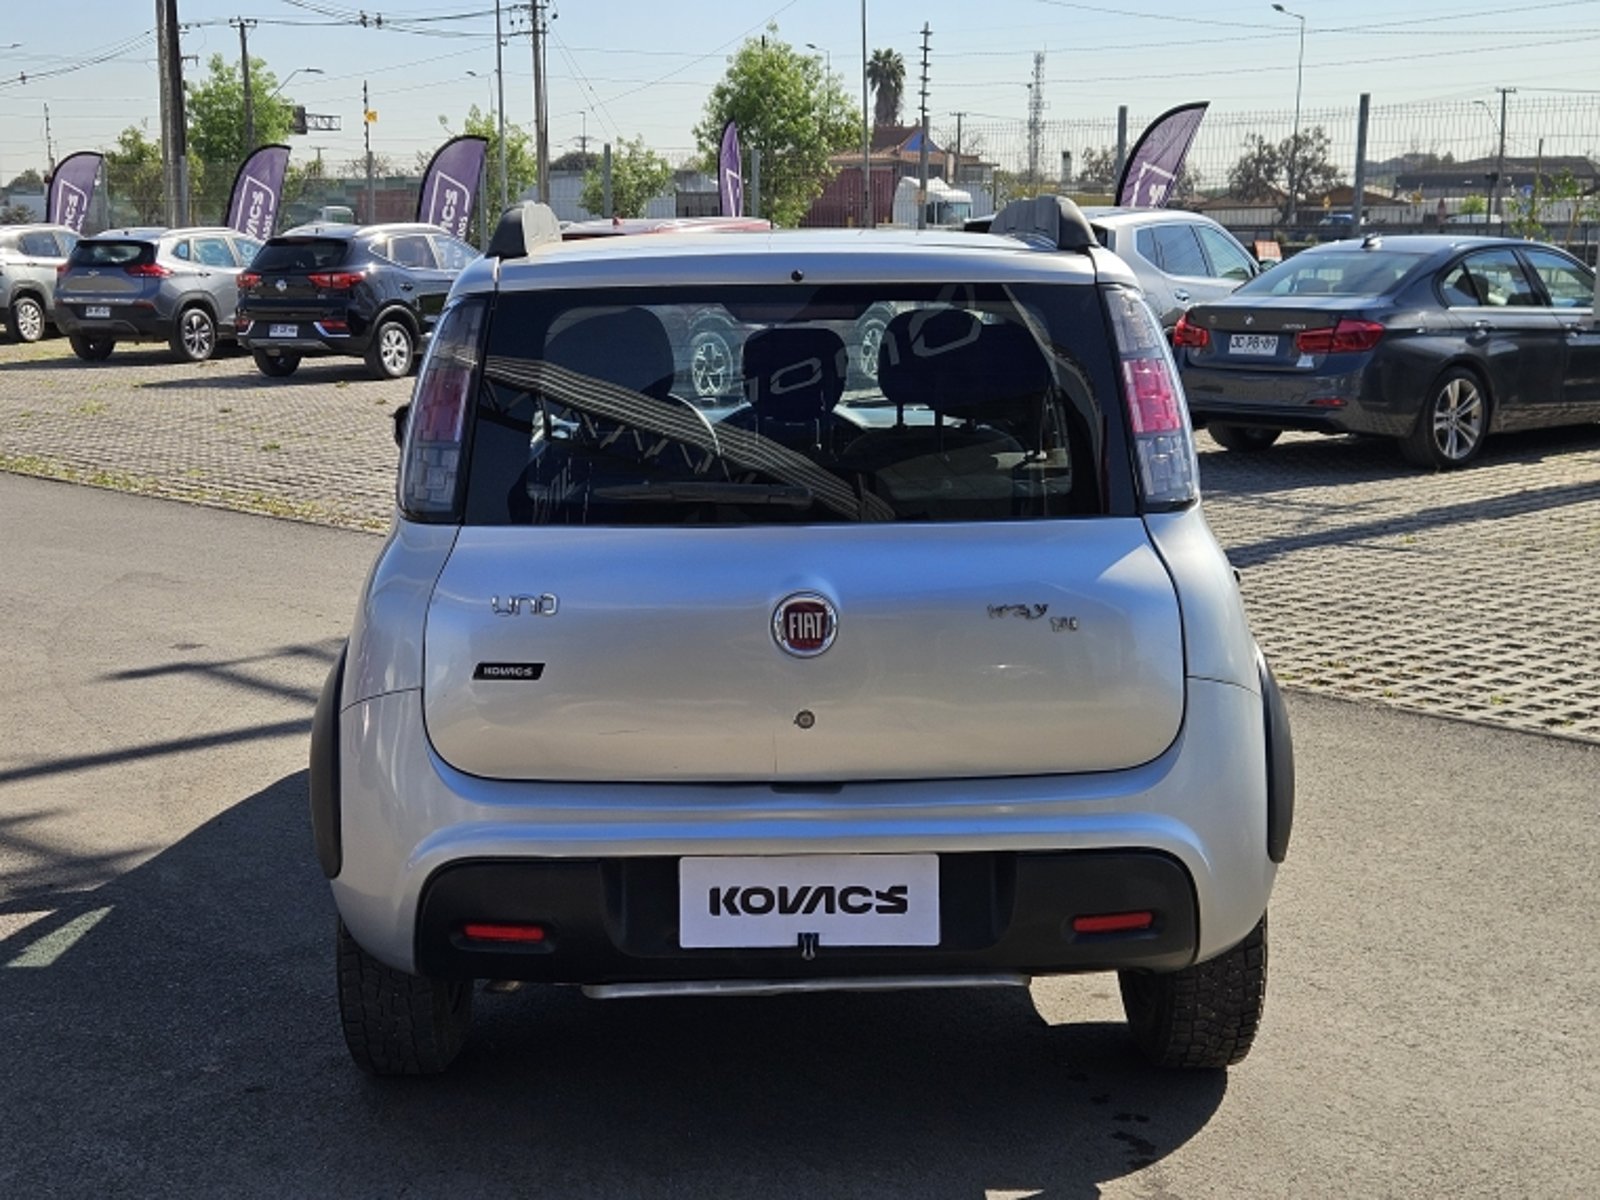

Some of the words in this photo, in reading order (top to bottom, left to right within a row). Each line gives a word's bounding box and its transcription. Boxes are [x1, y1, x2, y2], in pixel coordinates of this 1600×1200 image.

[788, 612, 823, 640] FIAT
[483, 666, 534, 677] KOVACS
[709, 885, 909, 916] KOVACS
